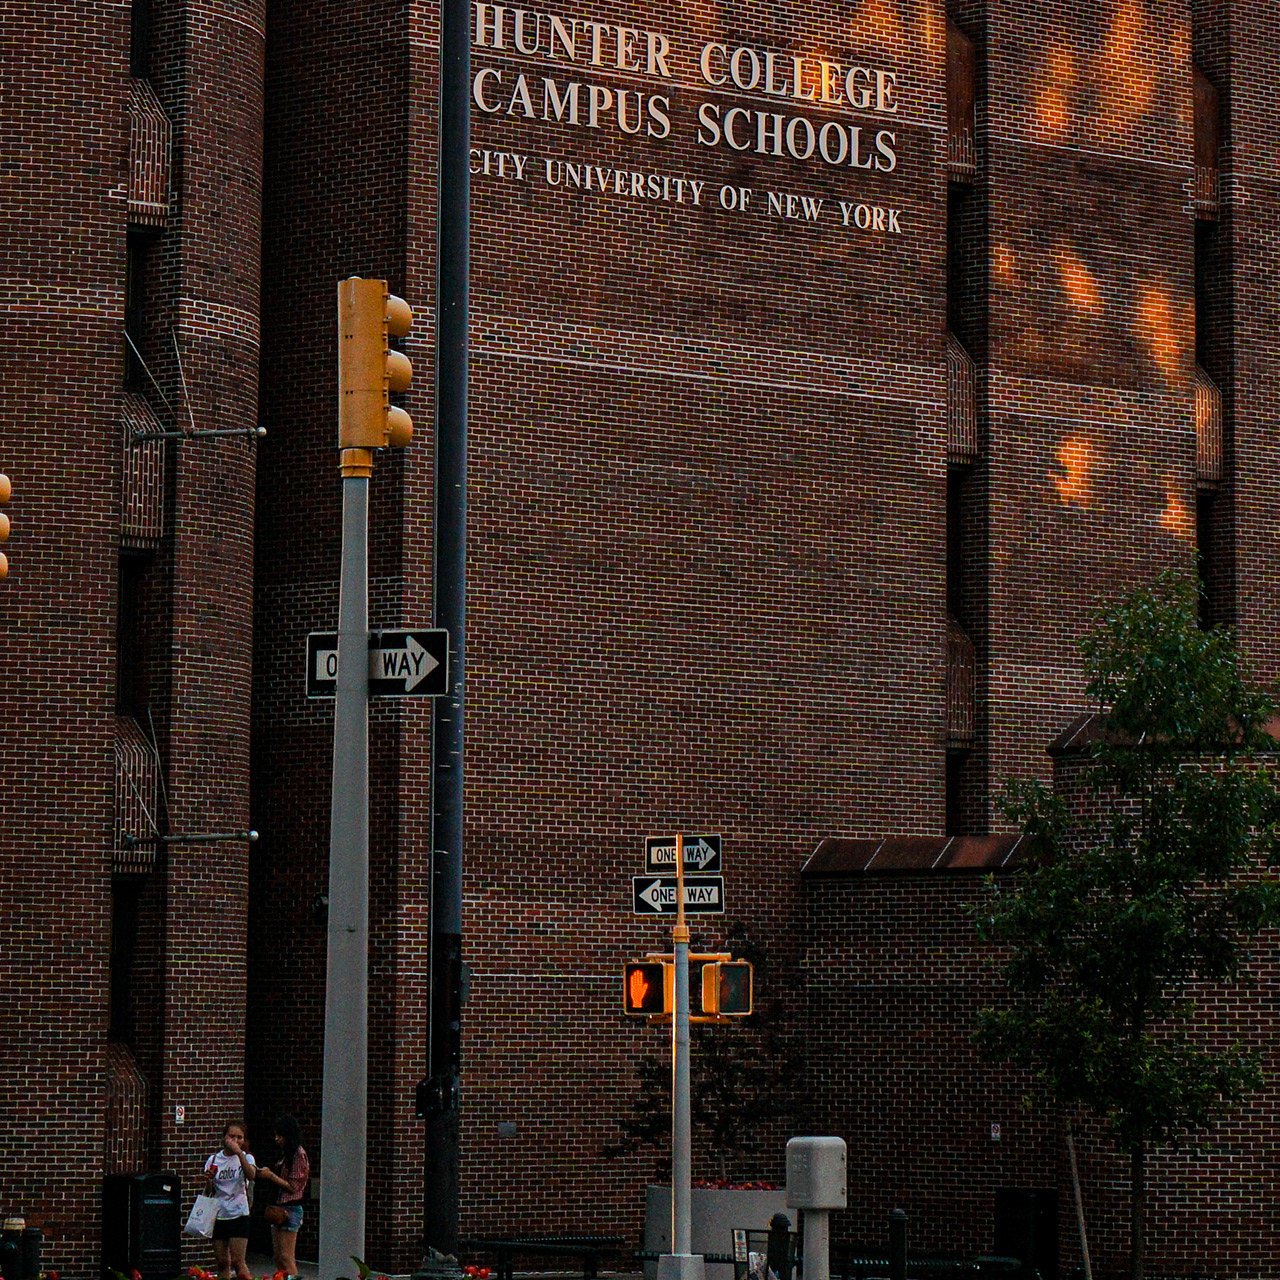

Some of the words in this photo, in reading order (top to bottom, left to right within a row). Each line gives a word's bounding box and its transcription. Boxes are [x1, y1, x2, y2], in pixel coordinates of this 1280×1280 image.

[473, 2, 672, 78] HUNTER
[700, 41, 898, 114] COLLEGE
[473, 68, 671, 139] CAMPUS
[698, 102, 897, 173] SCHOOLS
[469, 148, 528, 181] CITY
[545, 160, 705, 206] UNIVERSITY
[720, 185, 752, 212] OF
[767, 191, 824, 222] NEW
[838, 202, 902, 234] YORK
[383, 652, 424, 676] WAY
[656, 848, 677, 862] ONE
[686, 847, 709, 861] WAY
[651, 888, 676, 902] ONE
[687, 888, 713, 902] WAY
